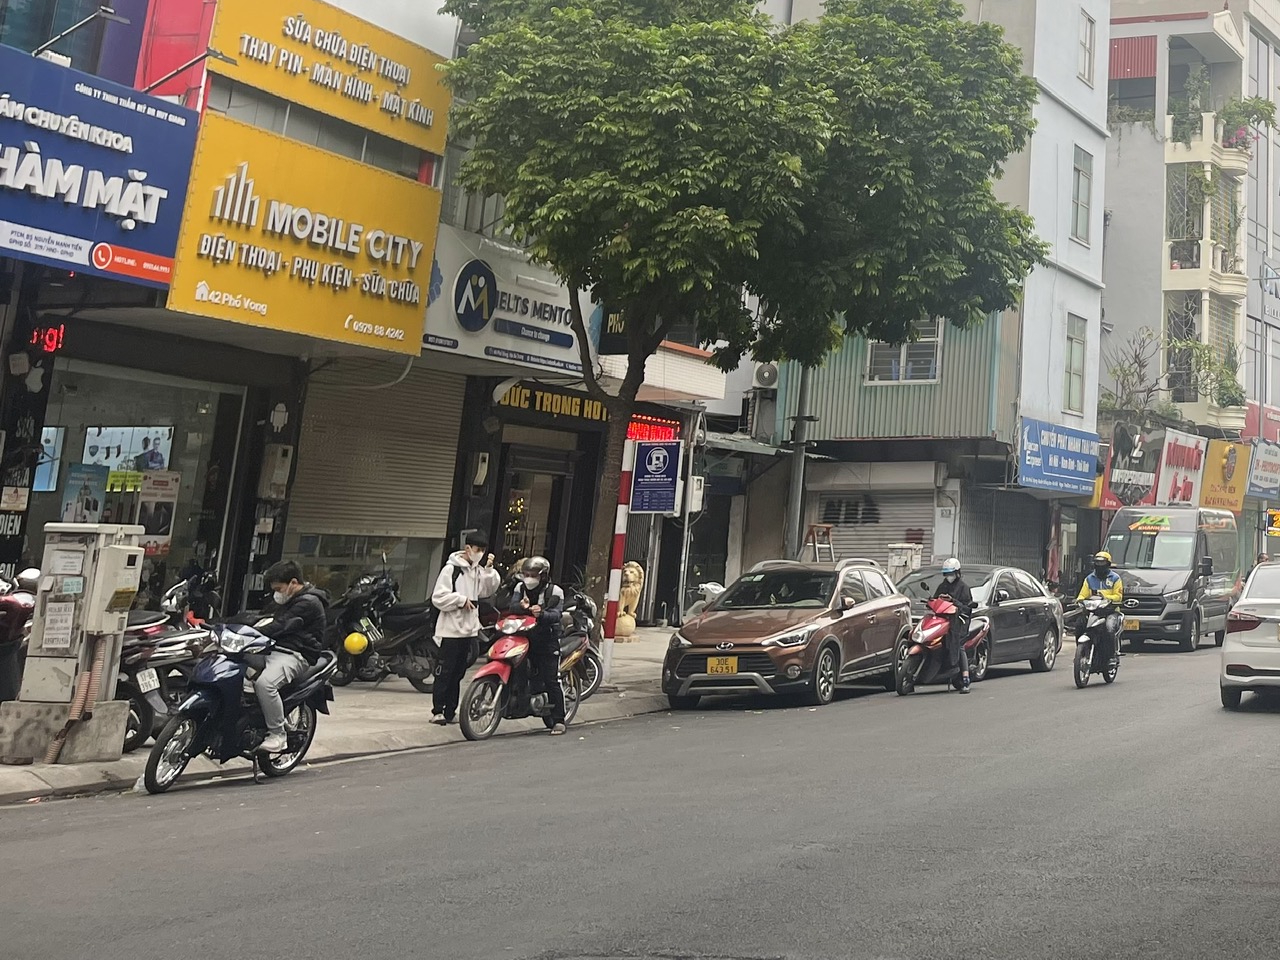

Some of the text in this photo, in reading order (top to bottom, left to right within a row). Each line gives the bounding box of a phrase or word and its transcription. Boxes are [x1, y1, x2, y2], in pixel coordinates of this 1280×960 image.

[240, 34, 277, 65] THAY
[278, 49, 303, 76] PIN
[310, 61, 341, 90] MÀN
[406, 98, 435, 129] KÍNH
[283, 13, 412, 89] SỬA CHỮA ĐIỆN THOẠI
[24, 106, 91, 141] CHUYÊN
[89, 126, 134, 154] KHOA
[83, 168, 169, 231] MẶT
[263, 199, 424, 269] MOBILE CITY
[198, 233, 421, 304] ĐIỆN THOẠI PHỤ KIỆN SỬA CHỮA
[208, 290, 268, 315] 42 Phố Vọng
[530, 300, 573, 328] MENTO
[534, 391, 581, 418] TRỌNG
